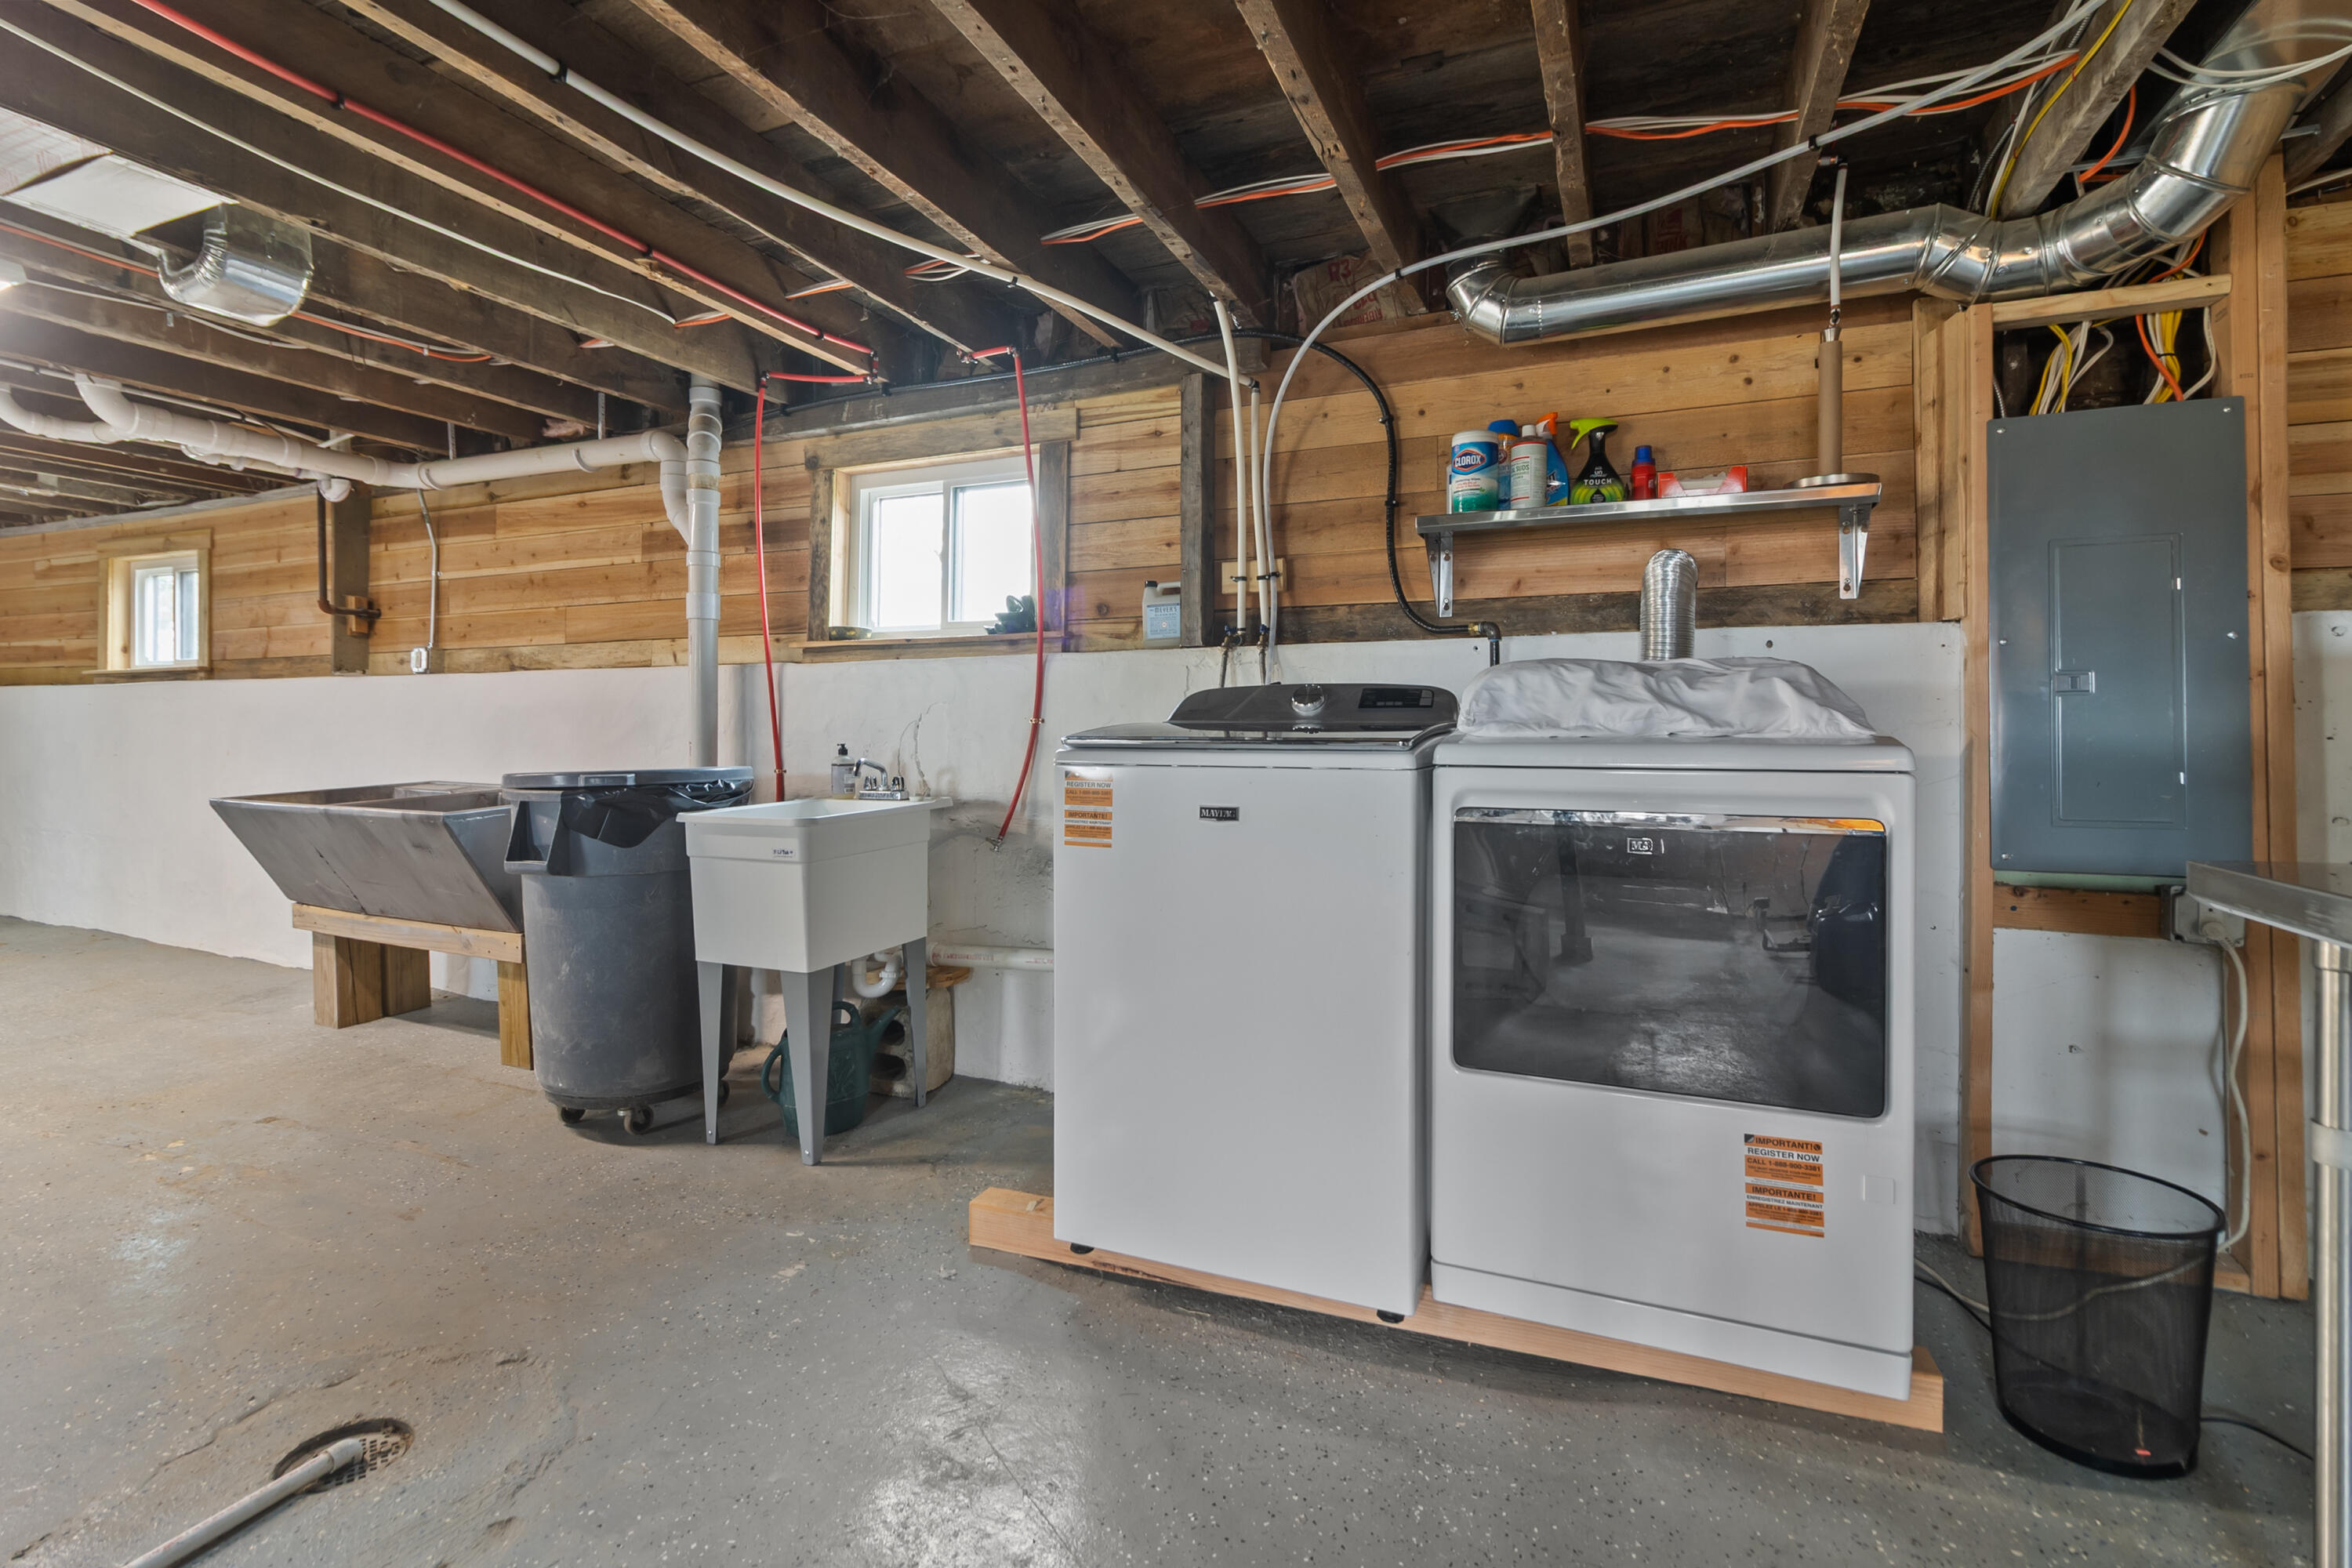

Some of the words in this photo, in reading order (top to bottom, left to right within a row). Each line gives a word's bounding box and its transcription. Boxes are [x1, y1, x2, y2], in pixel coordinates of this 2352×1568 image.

[1454, 455, 1481, 466] CLOROX
[1755, 1137, 1813, 1151] IMPORTANT!
[1747, 1147, 1795, 1160] REGISTER
[1796, 1152, 1820, 1163] NOW
[1747, 1157, 1766, 1166] CALL
[1751, 1185, 1816, 1201] IMPORTANTE!
[1747, 1195, 1784, 1204] ENREGISTREZ
[1786, 1200, 1823, 1209] MAINTENANT
